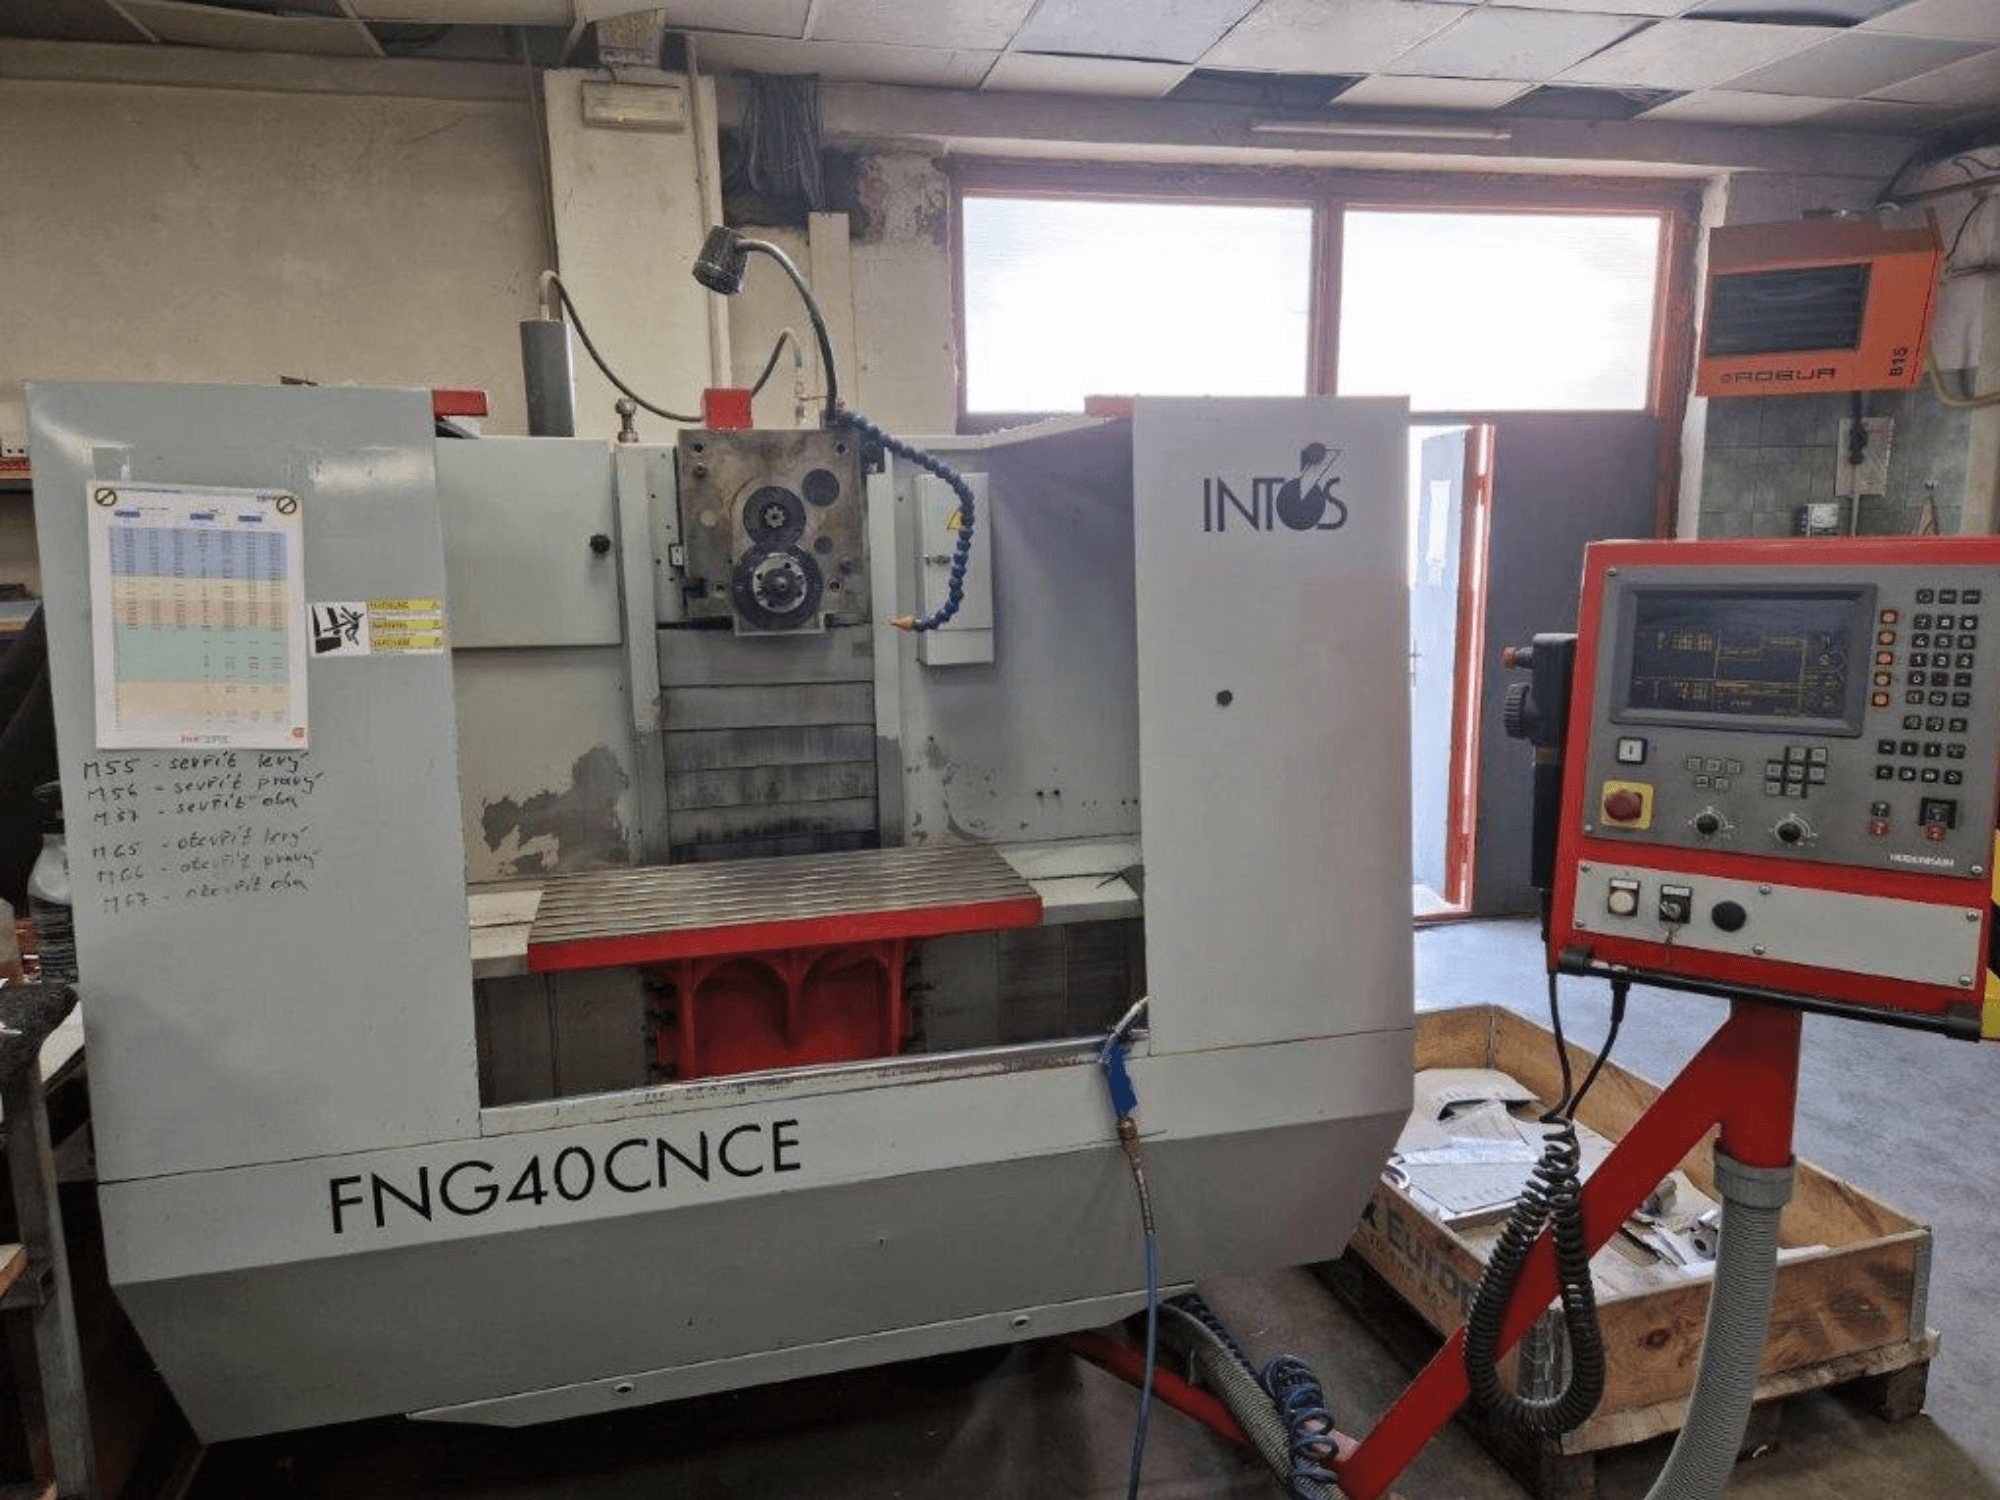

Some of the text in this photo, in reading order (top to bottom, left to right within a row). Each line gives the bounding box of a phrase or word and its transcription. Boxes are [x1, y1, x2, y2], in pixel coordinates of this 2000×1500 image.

[1889, 347, 1908, 377] B15
[1203, 477, 1348, 533] INTOS
[83, 757, 140, 780] M55
[88, 784, 138, 801] M56
[329, 1118, 801, 1234] FNG40CNCE
